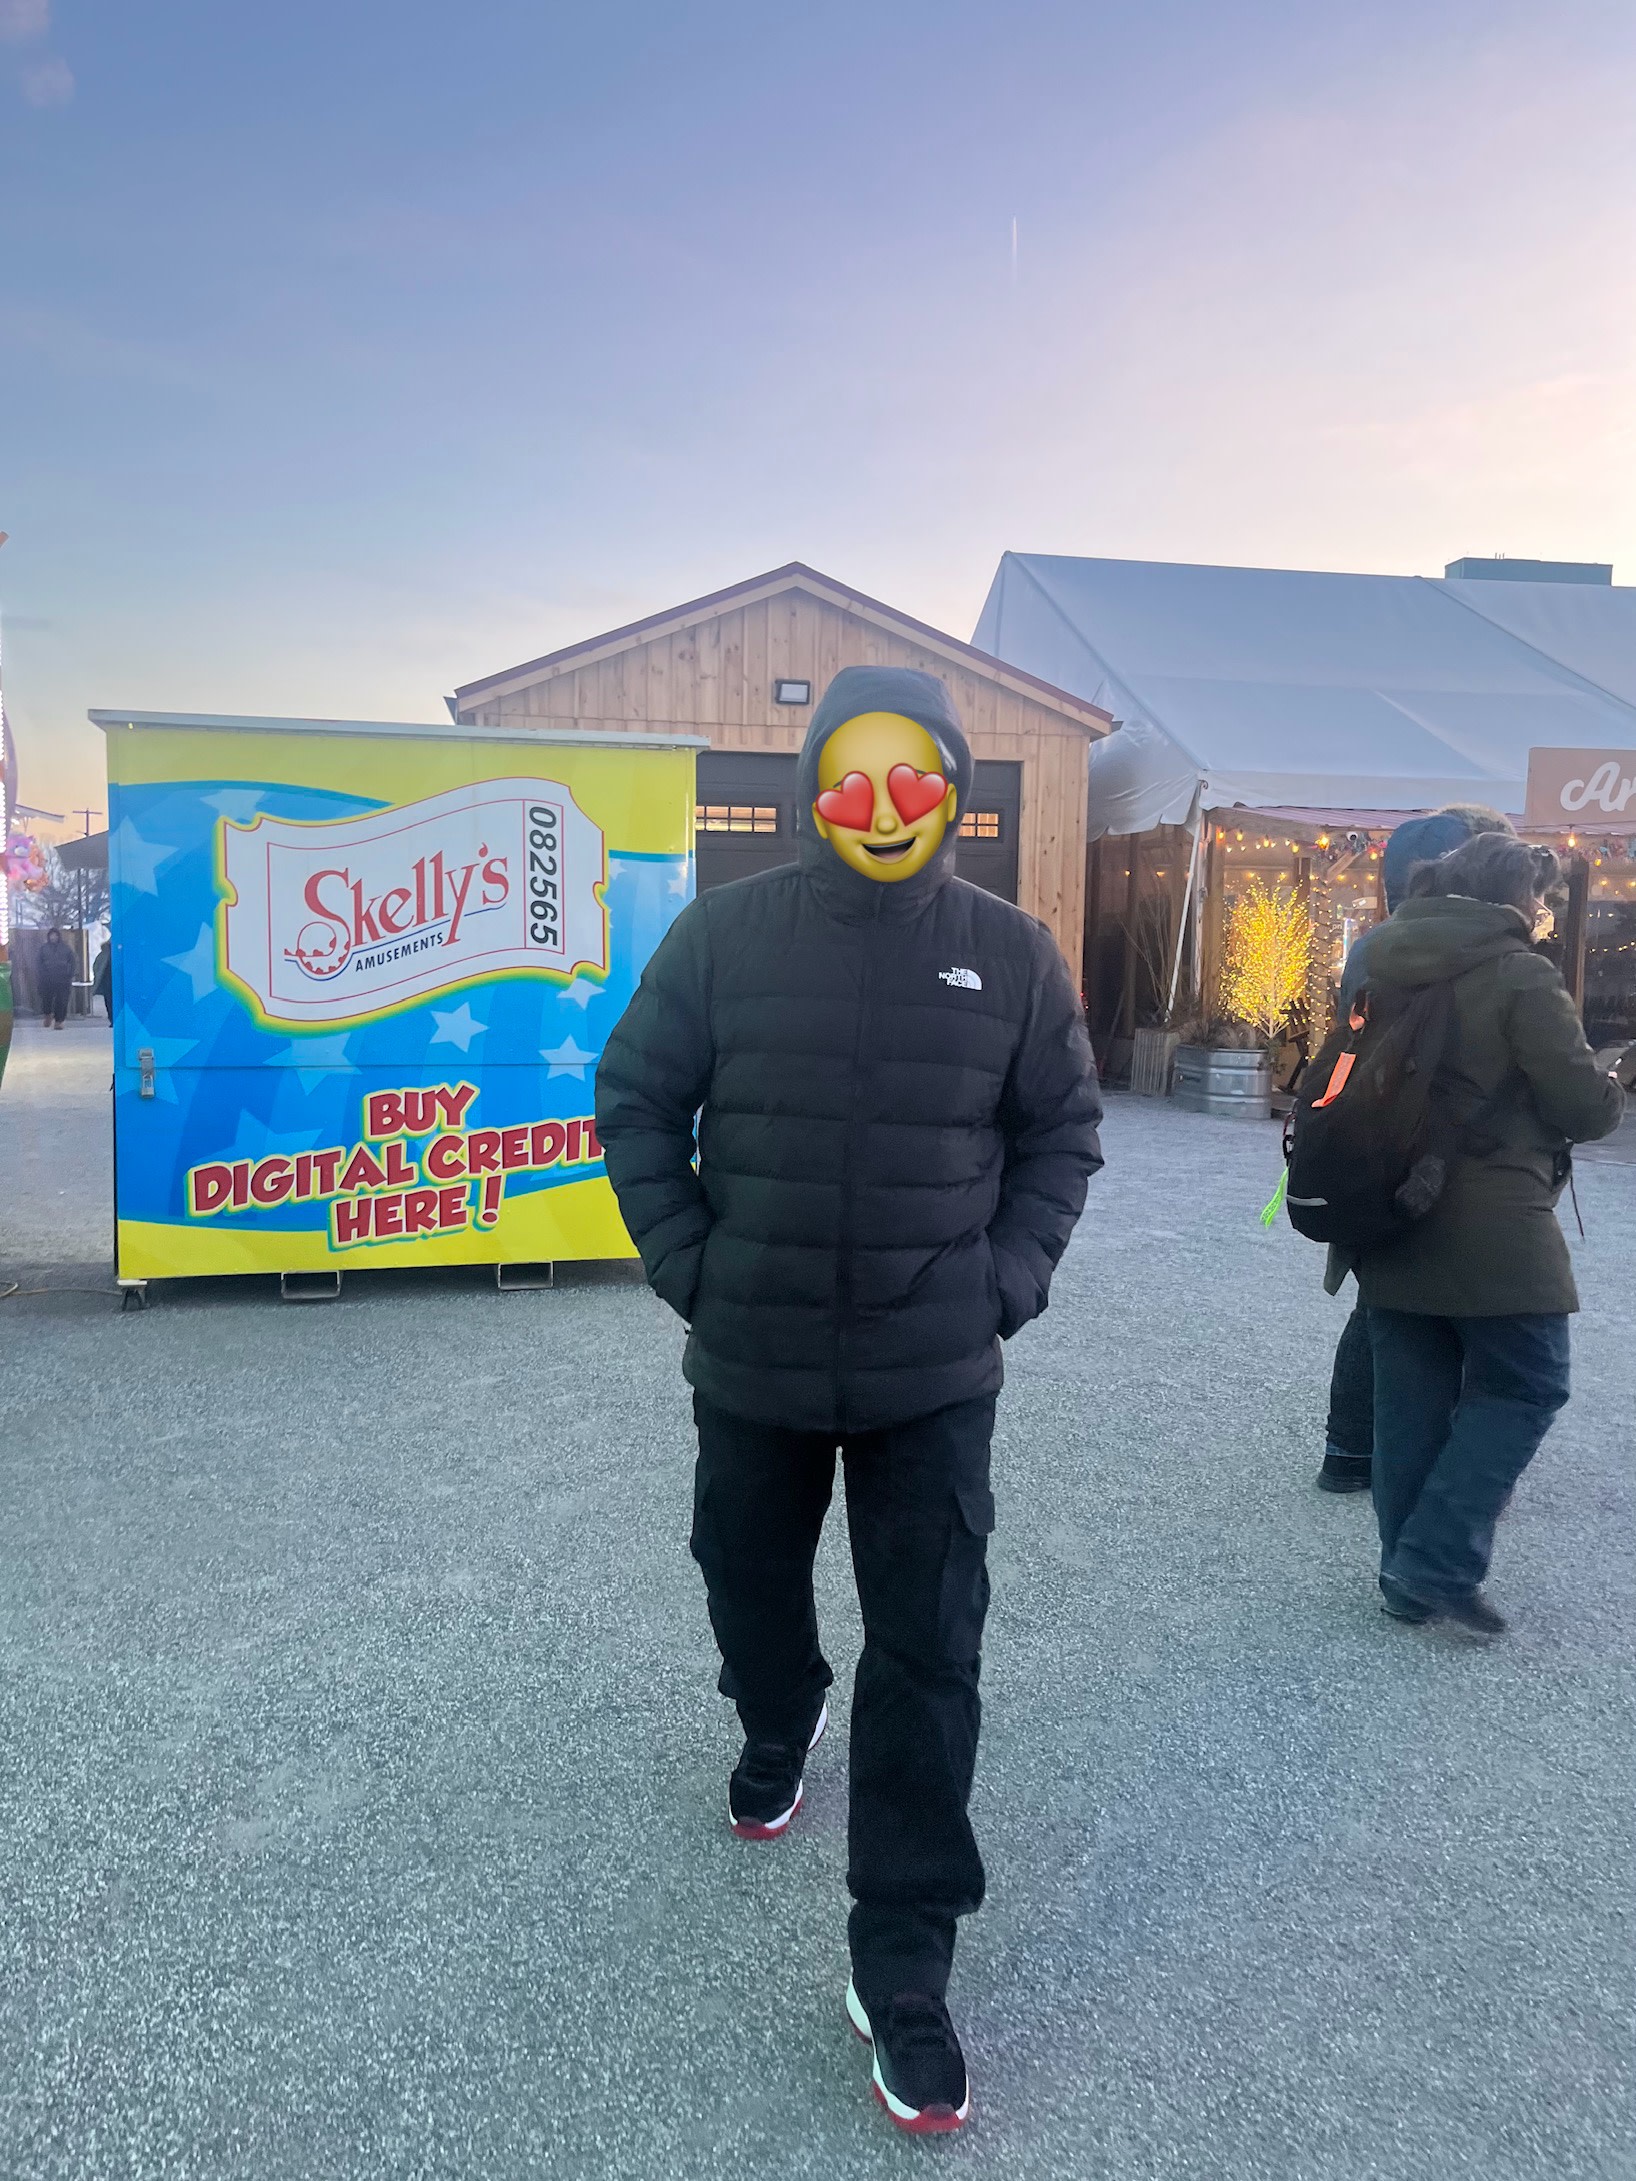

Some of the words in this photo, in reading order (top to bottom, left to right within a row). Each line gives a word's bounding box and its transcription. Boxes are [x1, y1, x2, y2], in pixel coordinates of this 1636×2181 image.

[529, 806, 558, 946] 082565
[290, 842, 510, 974] Skelly's
[355, 931, 444, 972] AMUSEMENTS
[951, 966, 968, 975] THE
[938, 971, 968, 982] NORTH
[946, 978, 968, 988] FACE
[369, 1084, 477, 1137] BUY
[193, 1142, 417, 1212] DIGITAL
